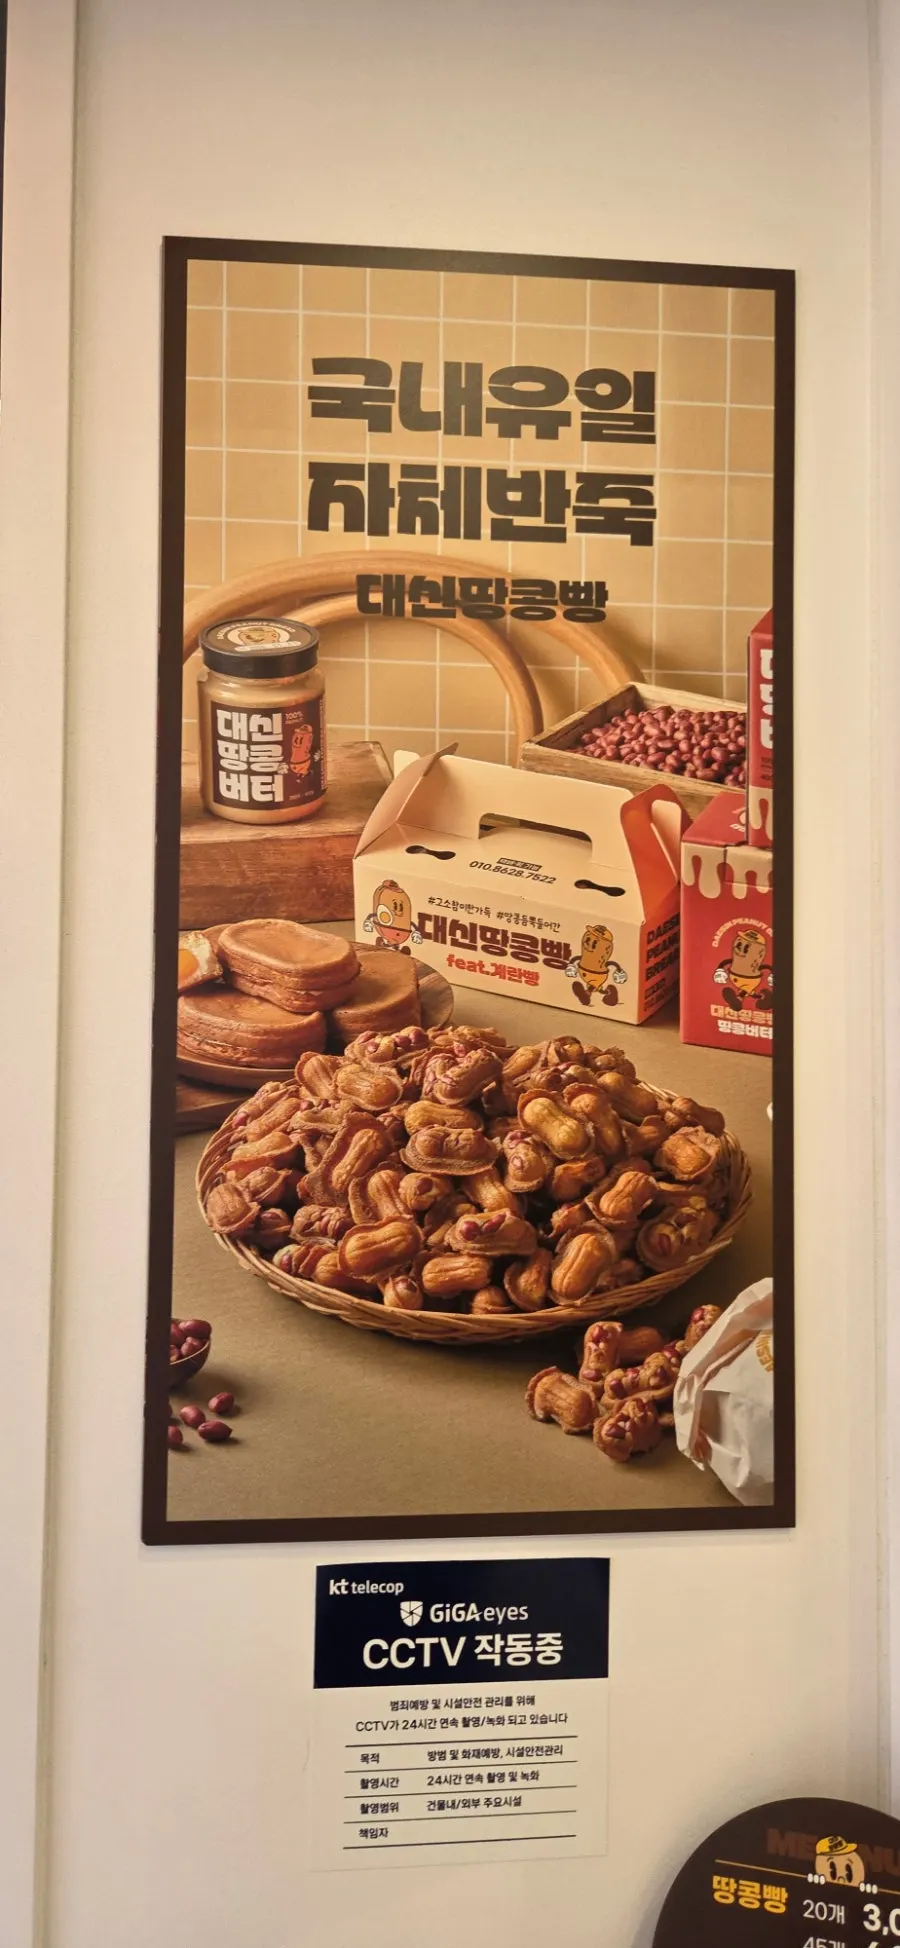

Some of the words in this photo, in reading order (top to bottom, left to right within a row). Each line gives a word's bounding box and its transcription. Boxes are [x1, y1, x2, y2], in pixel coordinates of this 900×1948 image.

[308, 357, 656, 445] 국내유일
[307, 461, 657, 547] 자체반죽
[356, 574, 608, 623] 대신땅콩빵
[216, 709, 283, 742] 대신
[217, 740, 283, 774] 땅콩
[218, 771, 284, 802] 버터
[469, 861, 556, 884] 010.8628.7522
[416, 912, 573, 971] 대신땅콩빵
[446, 953, 540, 986] feat.계란빵
[329, 1579, 349, 1595] kt
[351, 1579, 404, 1596] telecop
[363, 1636, 466, 1669] CCTV
[474, 1632, 563, 1666] 작동중
[390, 1699, 429, 1712] 범죄예방
[431, 1698, 441, 1710] 및
[443, 1697, 482, 1709] 시설안전
[484, 1695, 513, 1708] 관리를
[516, 1695, 535, 1706] 위해
[355, 1720, 399, 1732] CCTV가
[401, 1718, 437, 1730] 24시간
[440, 1717, 458, 1729] 연속
[462, 1715, 505, 1728] 촬영/녹화
[508, 1714, 527, 1725] 되고
[529, 1713, 568, 1725] 있습니다
[360, 1753, 380, 1764] 목적
[427, 1750, 446, 1761] 방범
[449, 1749, 459, 1760] 및
[505, 1744, 563, 1757] 시설안전관리
[360, 1777, 399, 1789] 촬영시간
[427, 1774, 461, 1786] 24시간
[465, 1773, 483, 1784] 연속
[487, 1772, 505, 1783] 촬영
[508, 1771, 517, 1782] 및
[521, 1770, 539, 1781] 녹화
[360, 1802, 399, 1814] 촬영범위
[427, 1798, 480, 1811] 건물내/외부
[484, 1796, 521, 1808] 주요시설
[359, 1827, 388, 1838] 책임자
[712, 1875, 788, 1914] 땅콩빵
[802, 1899, 845, 1925] 20개
